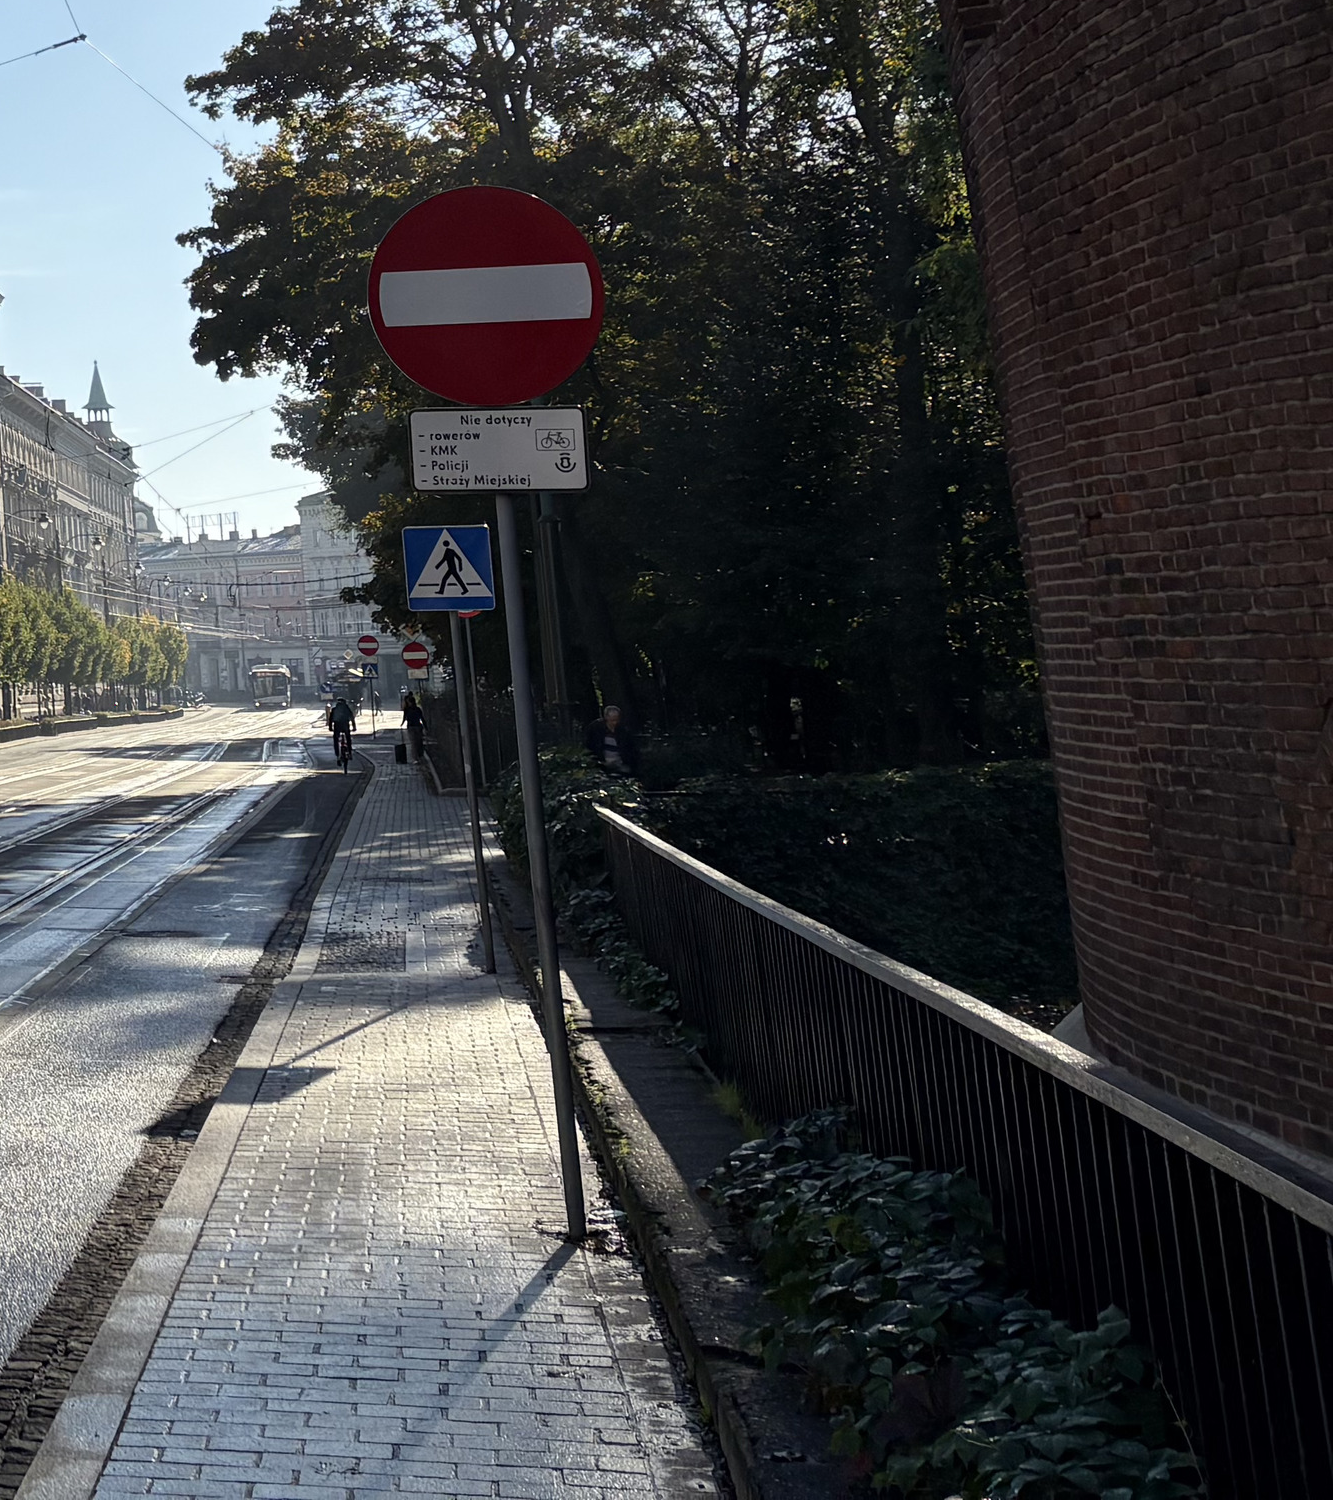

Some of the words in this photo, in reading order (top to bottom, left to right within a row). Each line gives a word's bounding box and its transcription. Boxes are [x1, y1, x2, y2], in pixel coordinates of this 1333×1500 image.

[460, 415, 481, 426] Nie
[485, 414, 533, 427] dotyczy
[429, 429, 481, 441] rowerów
[430, 445, 458, 456] KMK
[431, 460, 469, 472] Policji
[432, 476, 470, 488] Straży
[474, 475, 531, 487] Miejskiej
